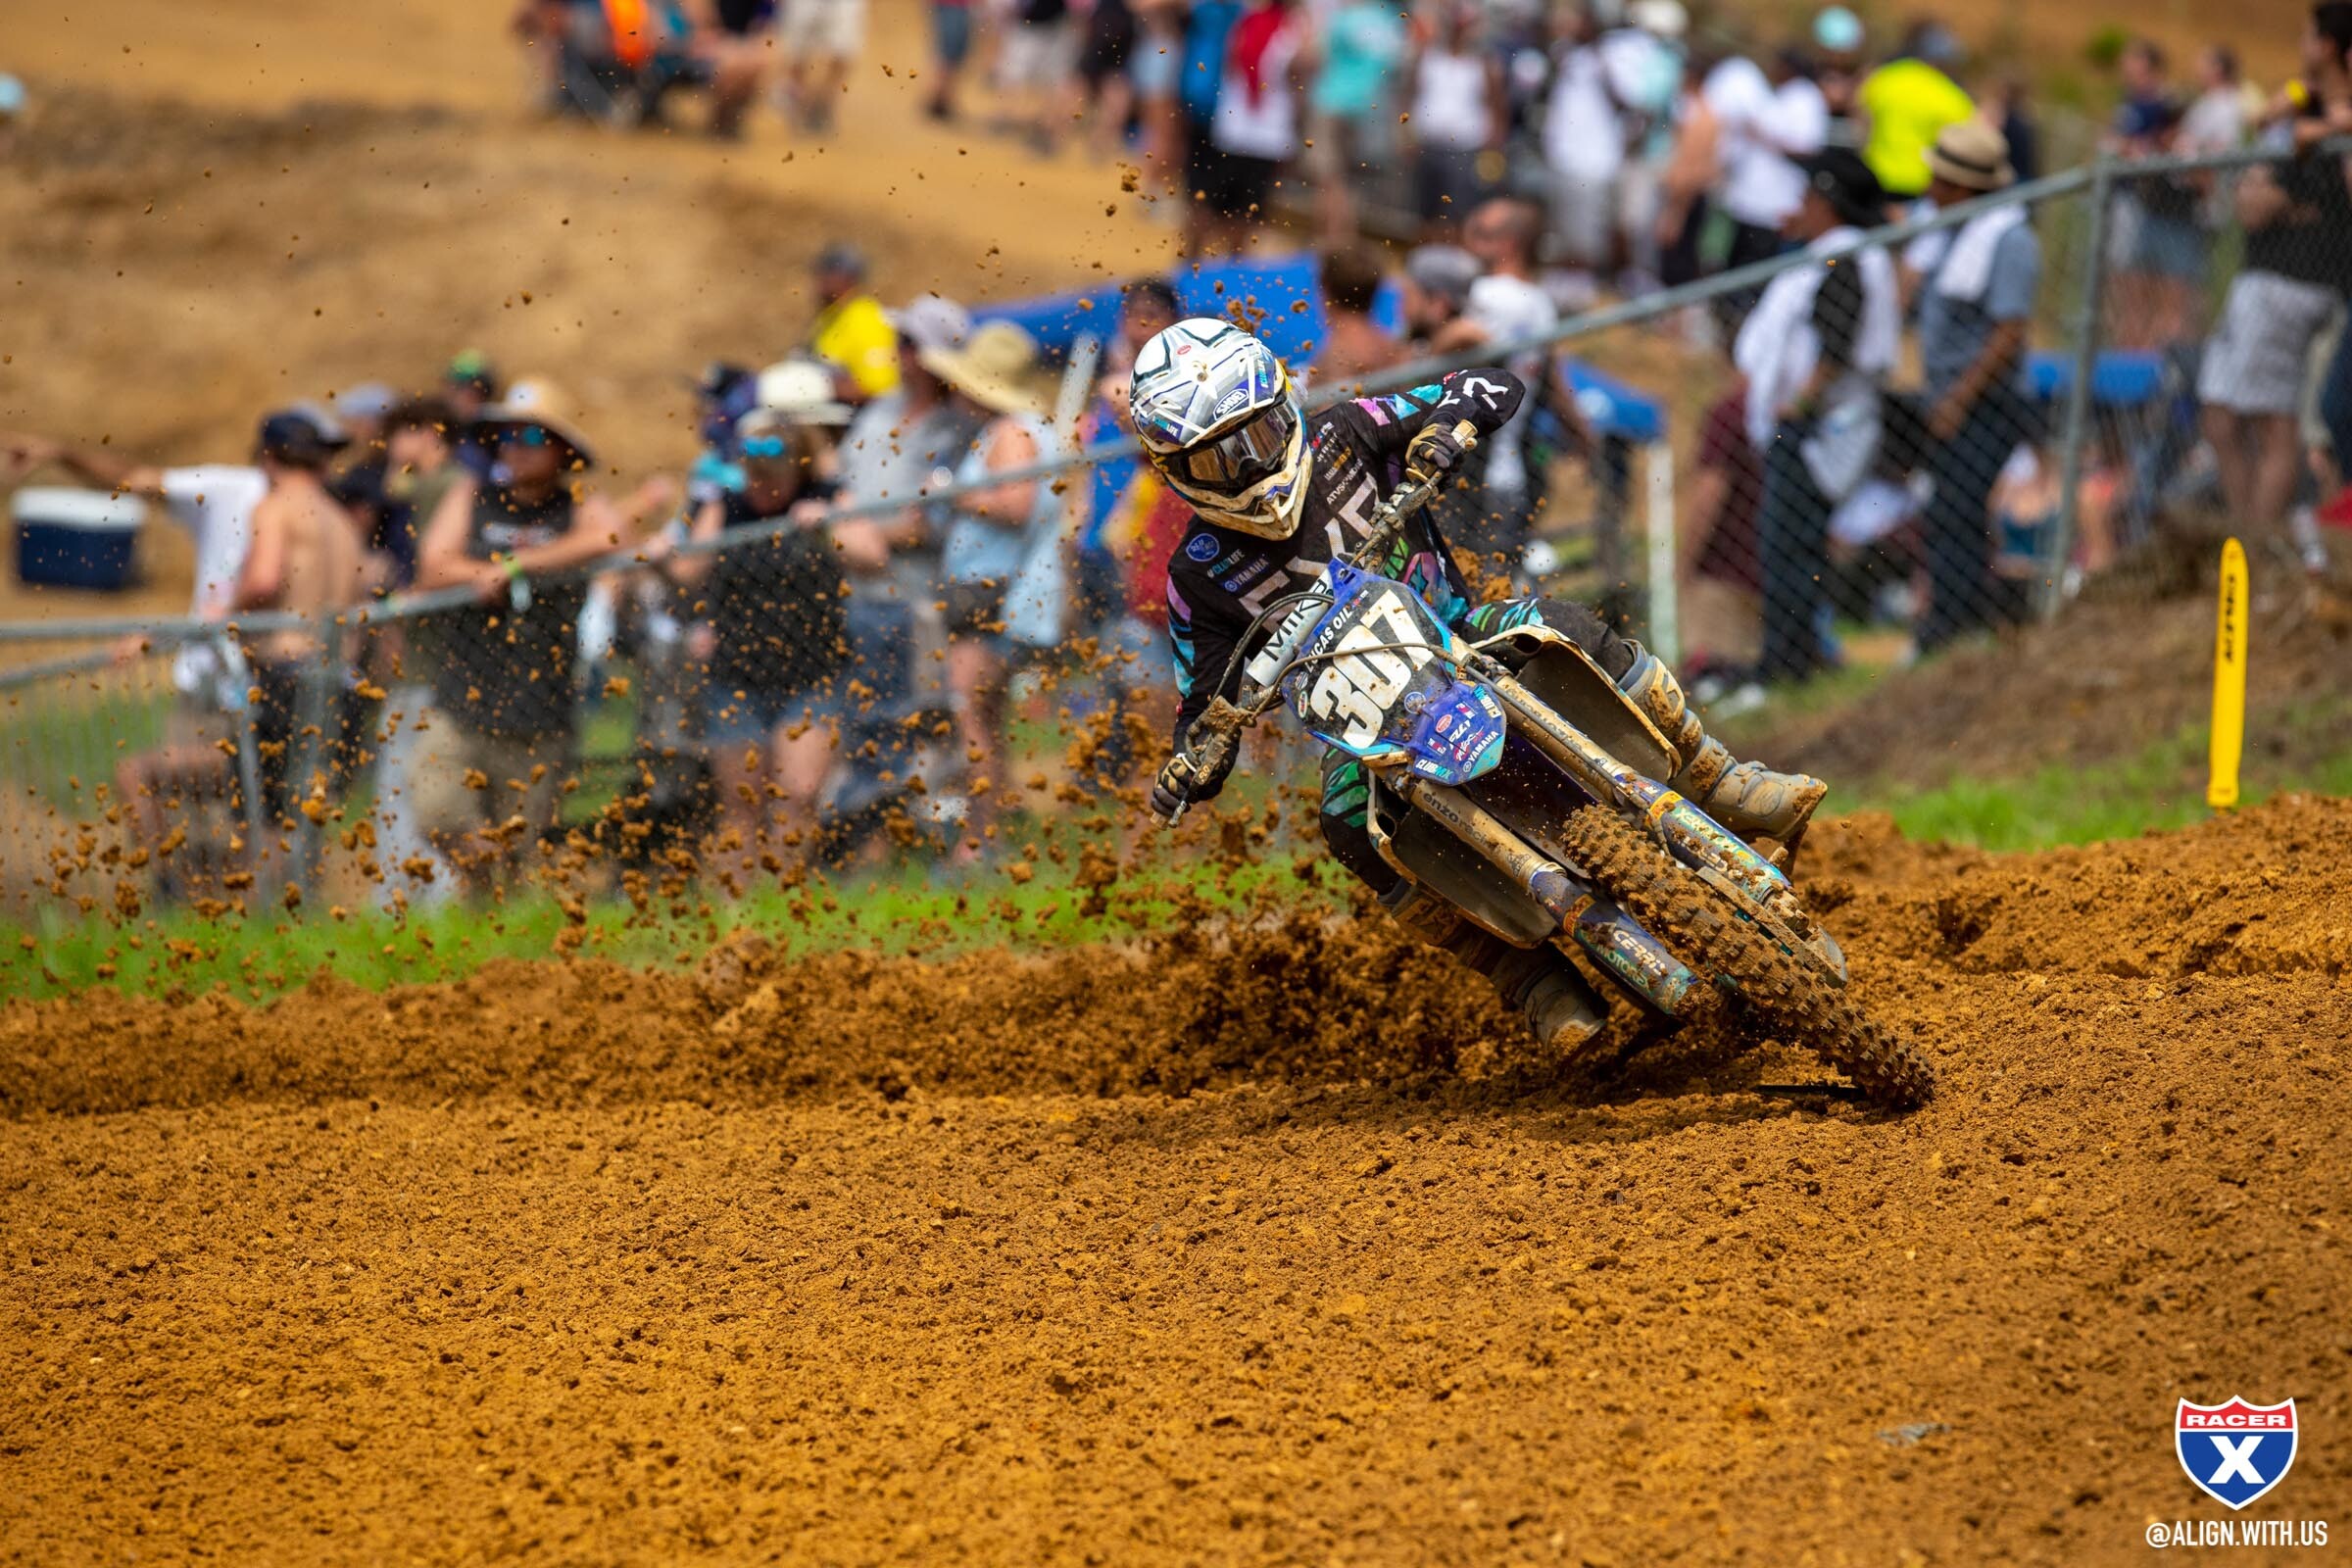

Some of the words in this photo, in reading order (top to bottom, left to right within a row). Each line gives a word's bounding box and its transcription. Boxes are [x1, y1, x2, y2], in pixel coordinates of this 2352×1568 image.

[1216, 390, 1246, 416] SHOEI
[1233, 557, 1270, 585] YAMAHA
[1304, 626, 1334, 673] LUCAS
[1333, 607, 1352, 630] OIL
[1310, 589, 1436, 750] 307
[1467, 730, 1499, 762] YAMAHA
[1415, 759, 1453, 780] CLUBMX
[1423, 792, 1460, 823] enzo
